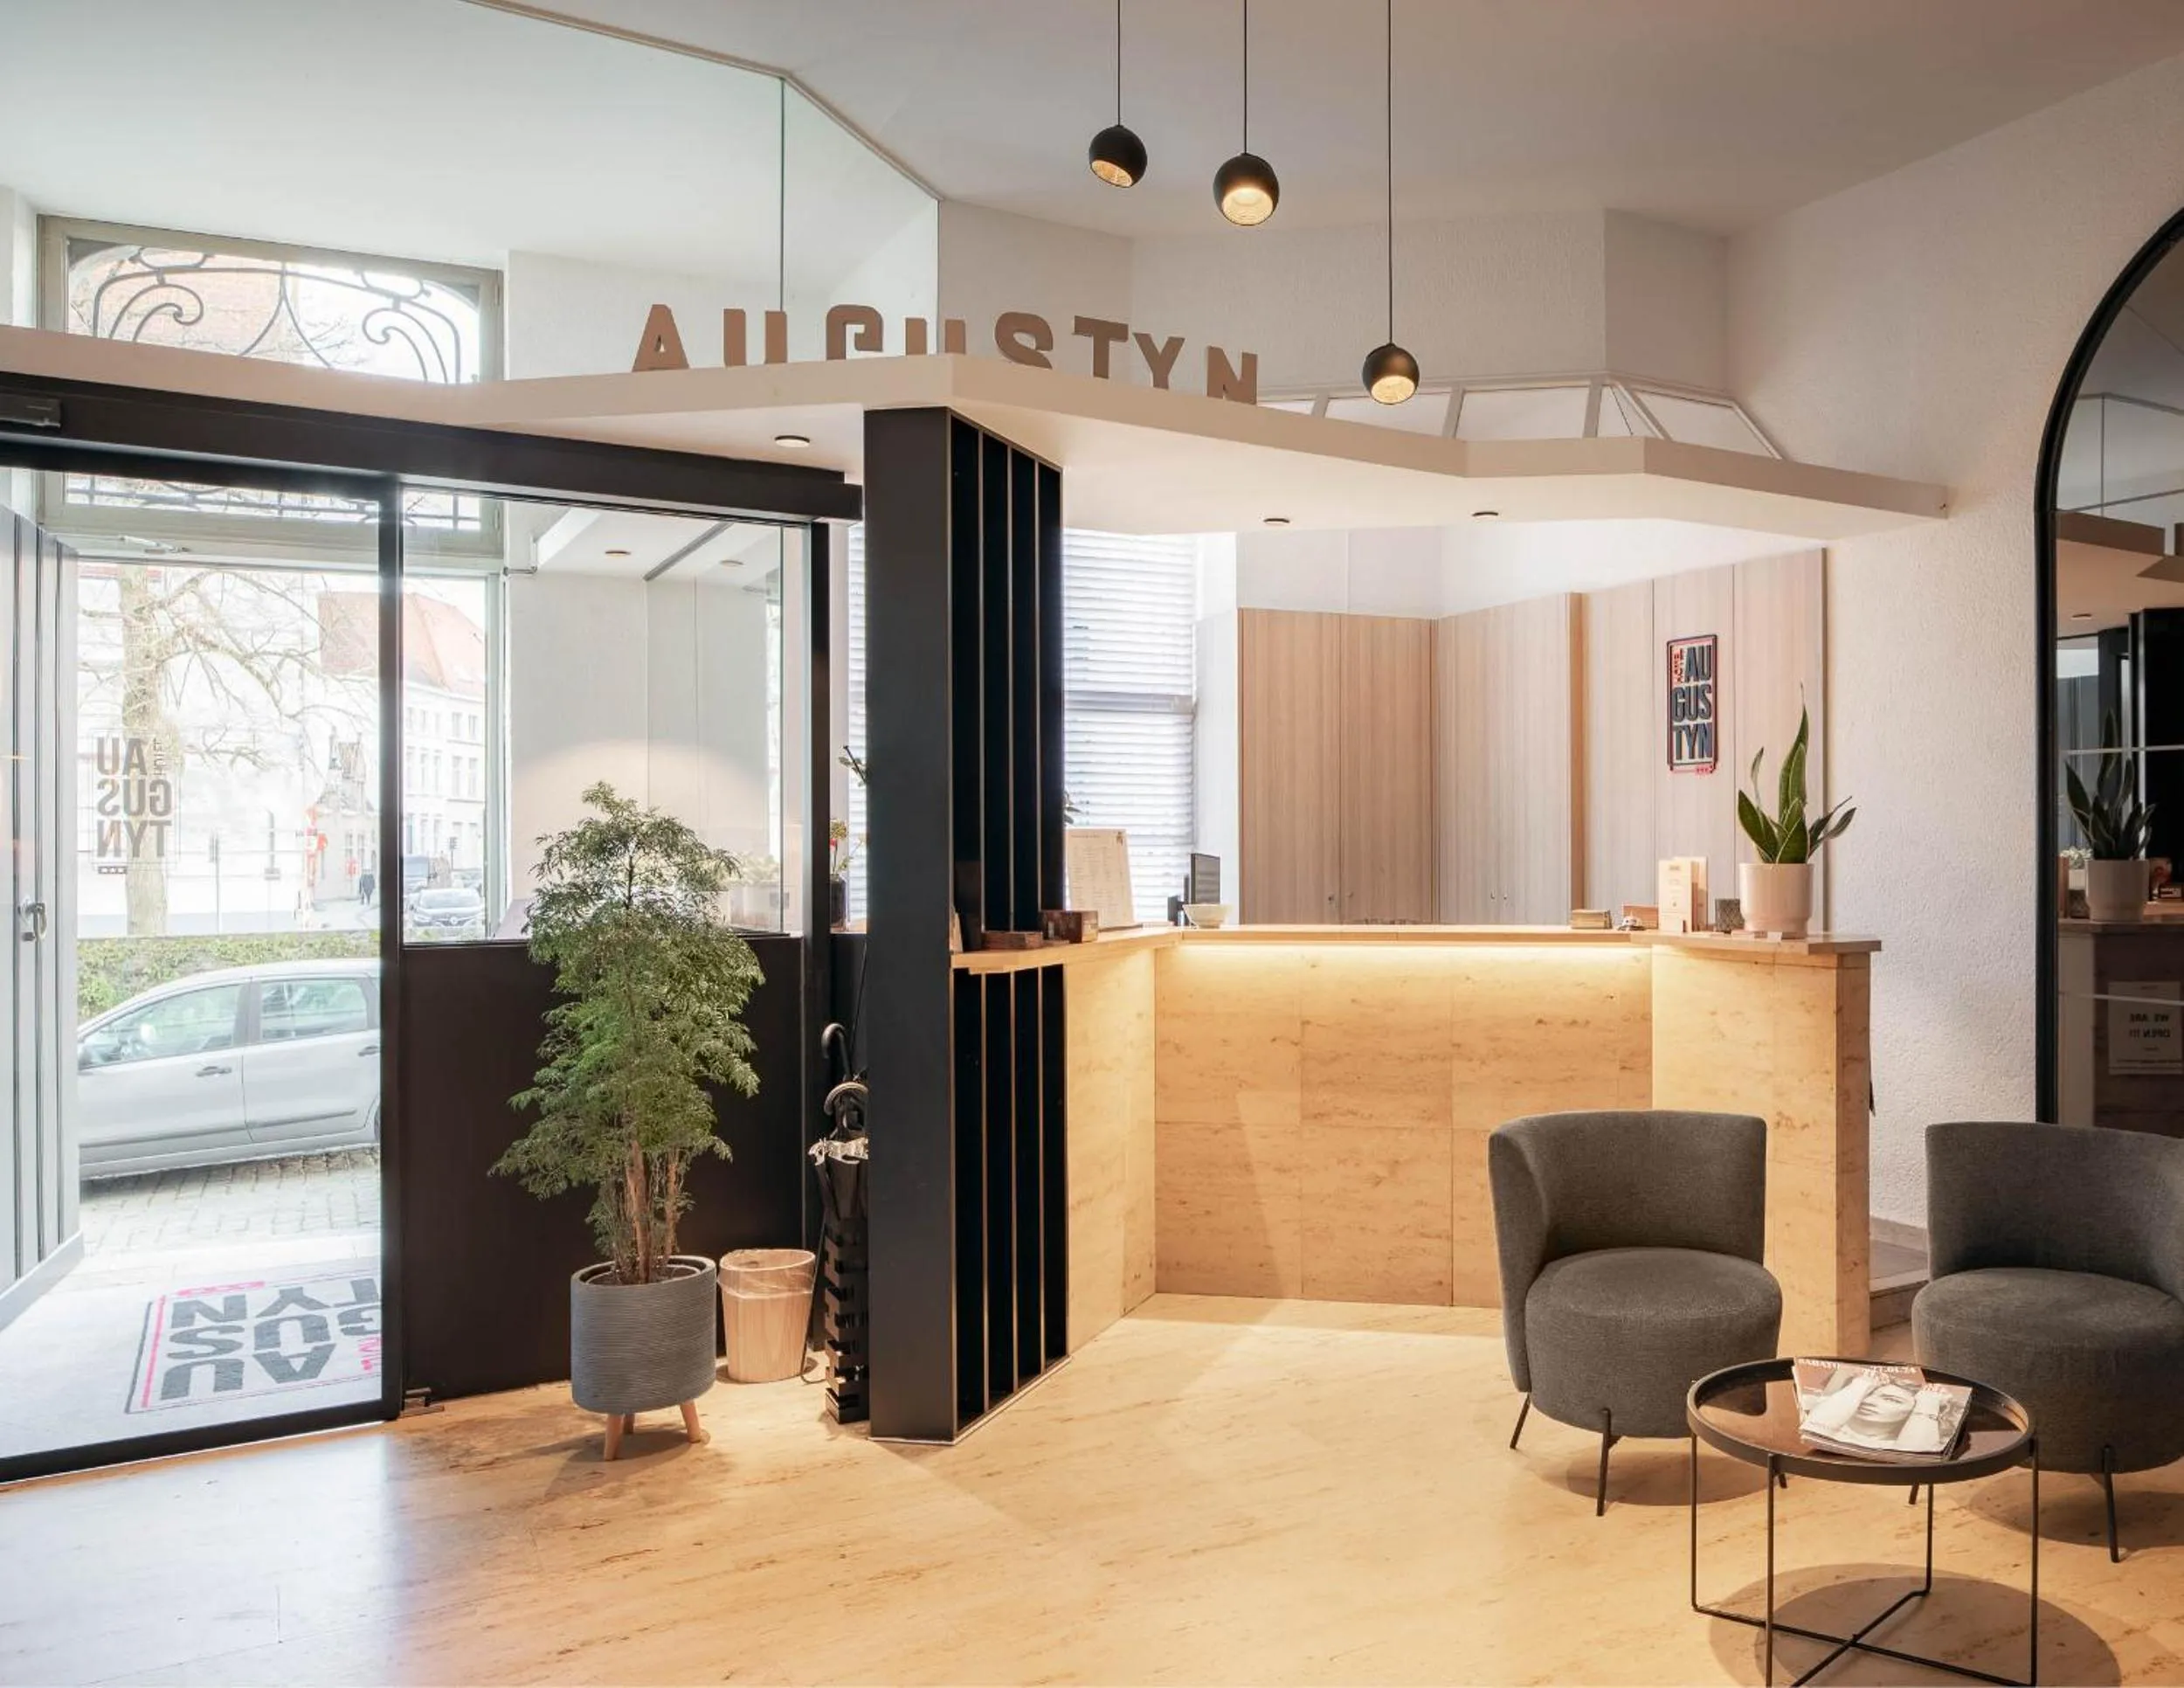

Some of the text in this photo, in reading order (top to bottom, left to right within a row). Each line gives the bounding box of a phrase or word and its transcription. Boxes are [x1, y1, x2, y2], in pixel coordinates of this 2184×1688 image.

[632, 304, 1258, 405] AUGUSTYN
[1684, 645, 1712, 683] AU
[1672, 684, 1712, 723] GUS
[1673, 723, 1712, 760] TYN
[160, 1343, 337, 1401] AU
